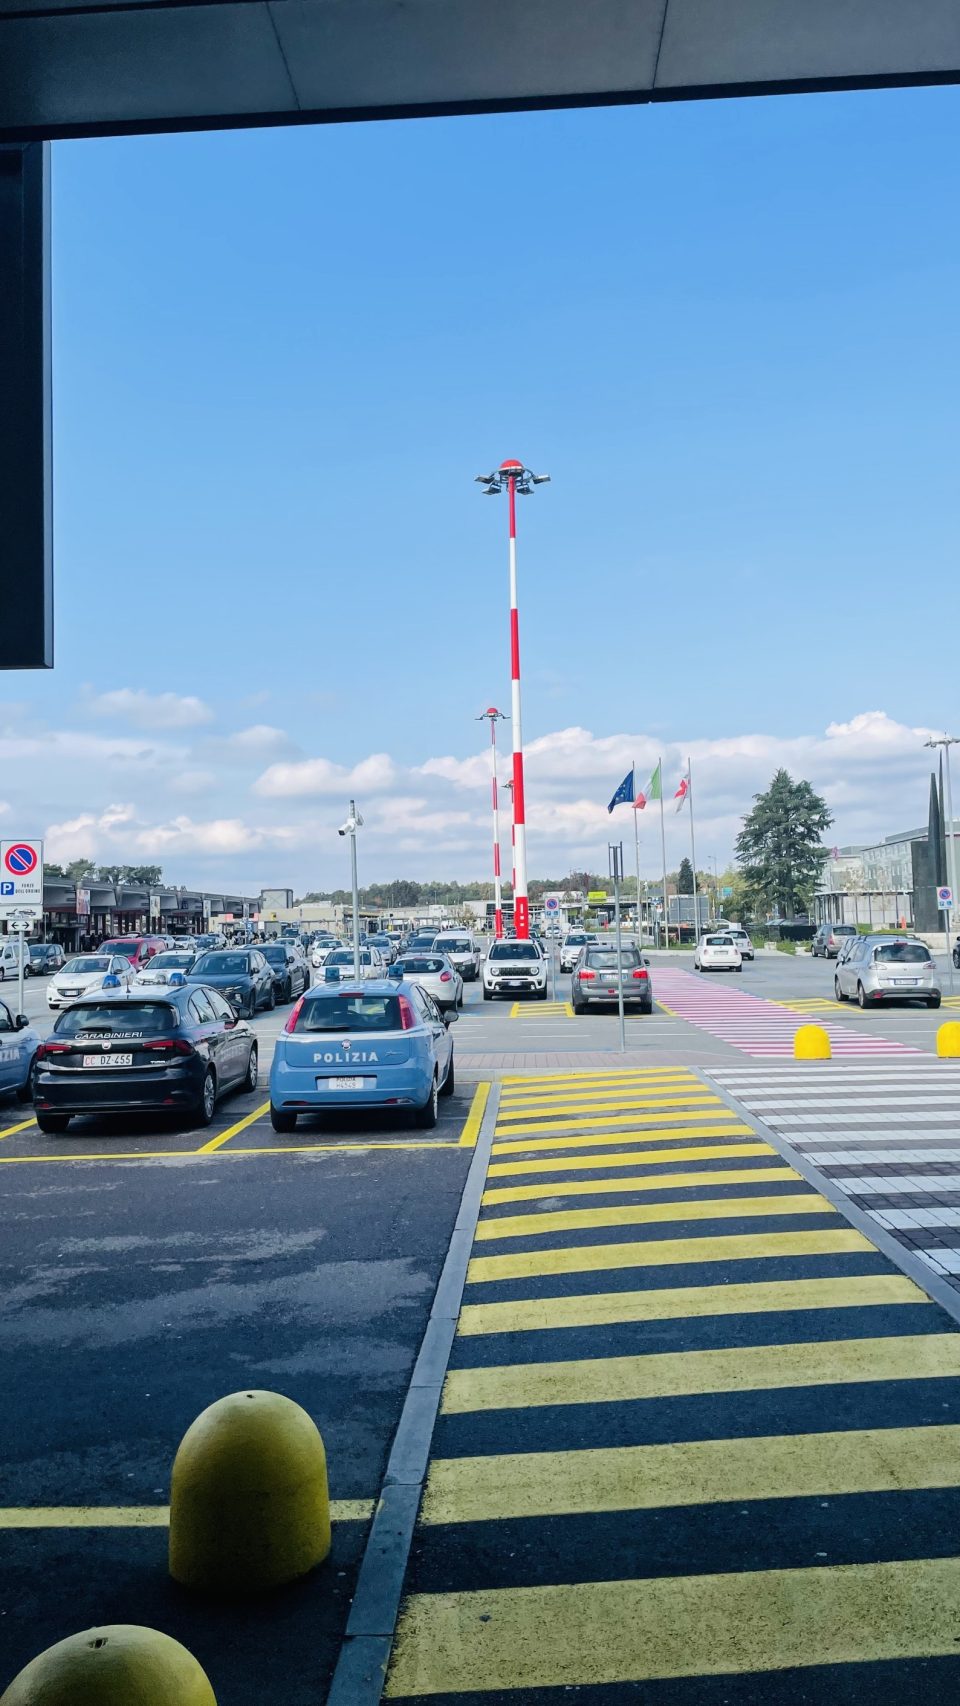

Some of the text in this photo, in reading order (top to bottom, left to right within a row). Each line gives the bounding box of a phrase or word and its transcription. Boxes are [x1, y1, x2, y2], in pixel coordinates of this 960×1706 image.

[74, 1031, 143, 1040] CARABINIERI
[85, 1056, 96, 1065] CC
[313, 1052, 379, 1063] POLIZIA
